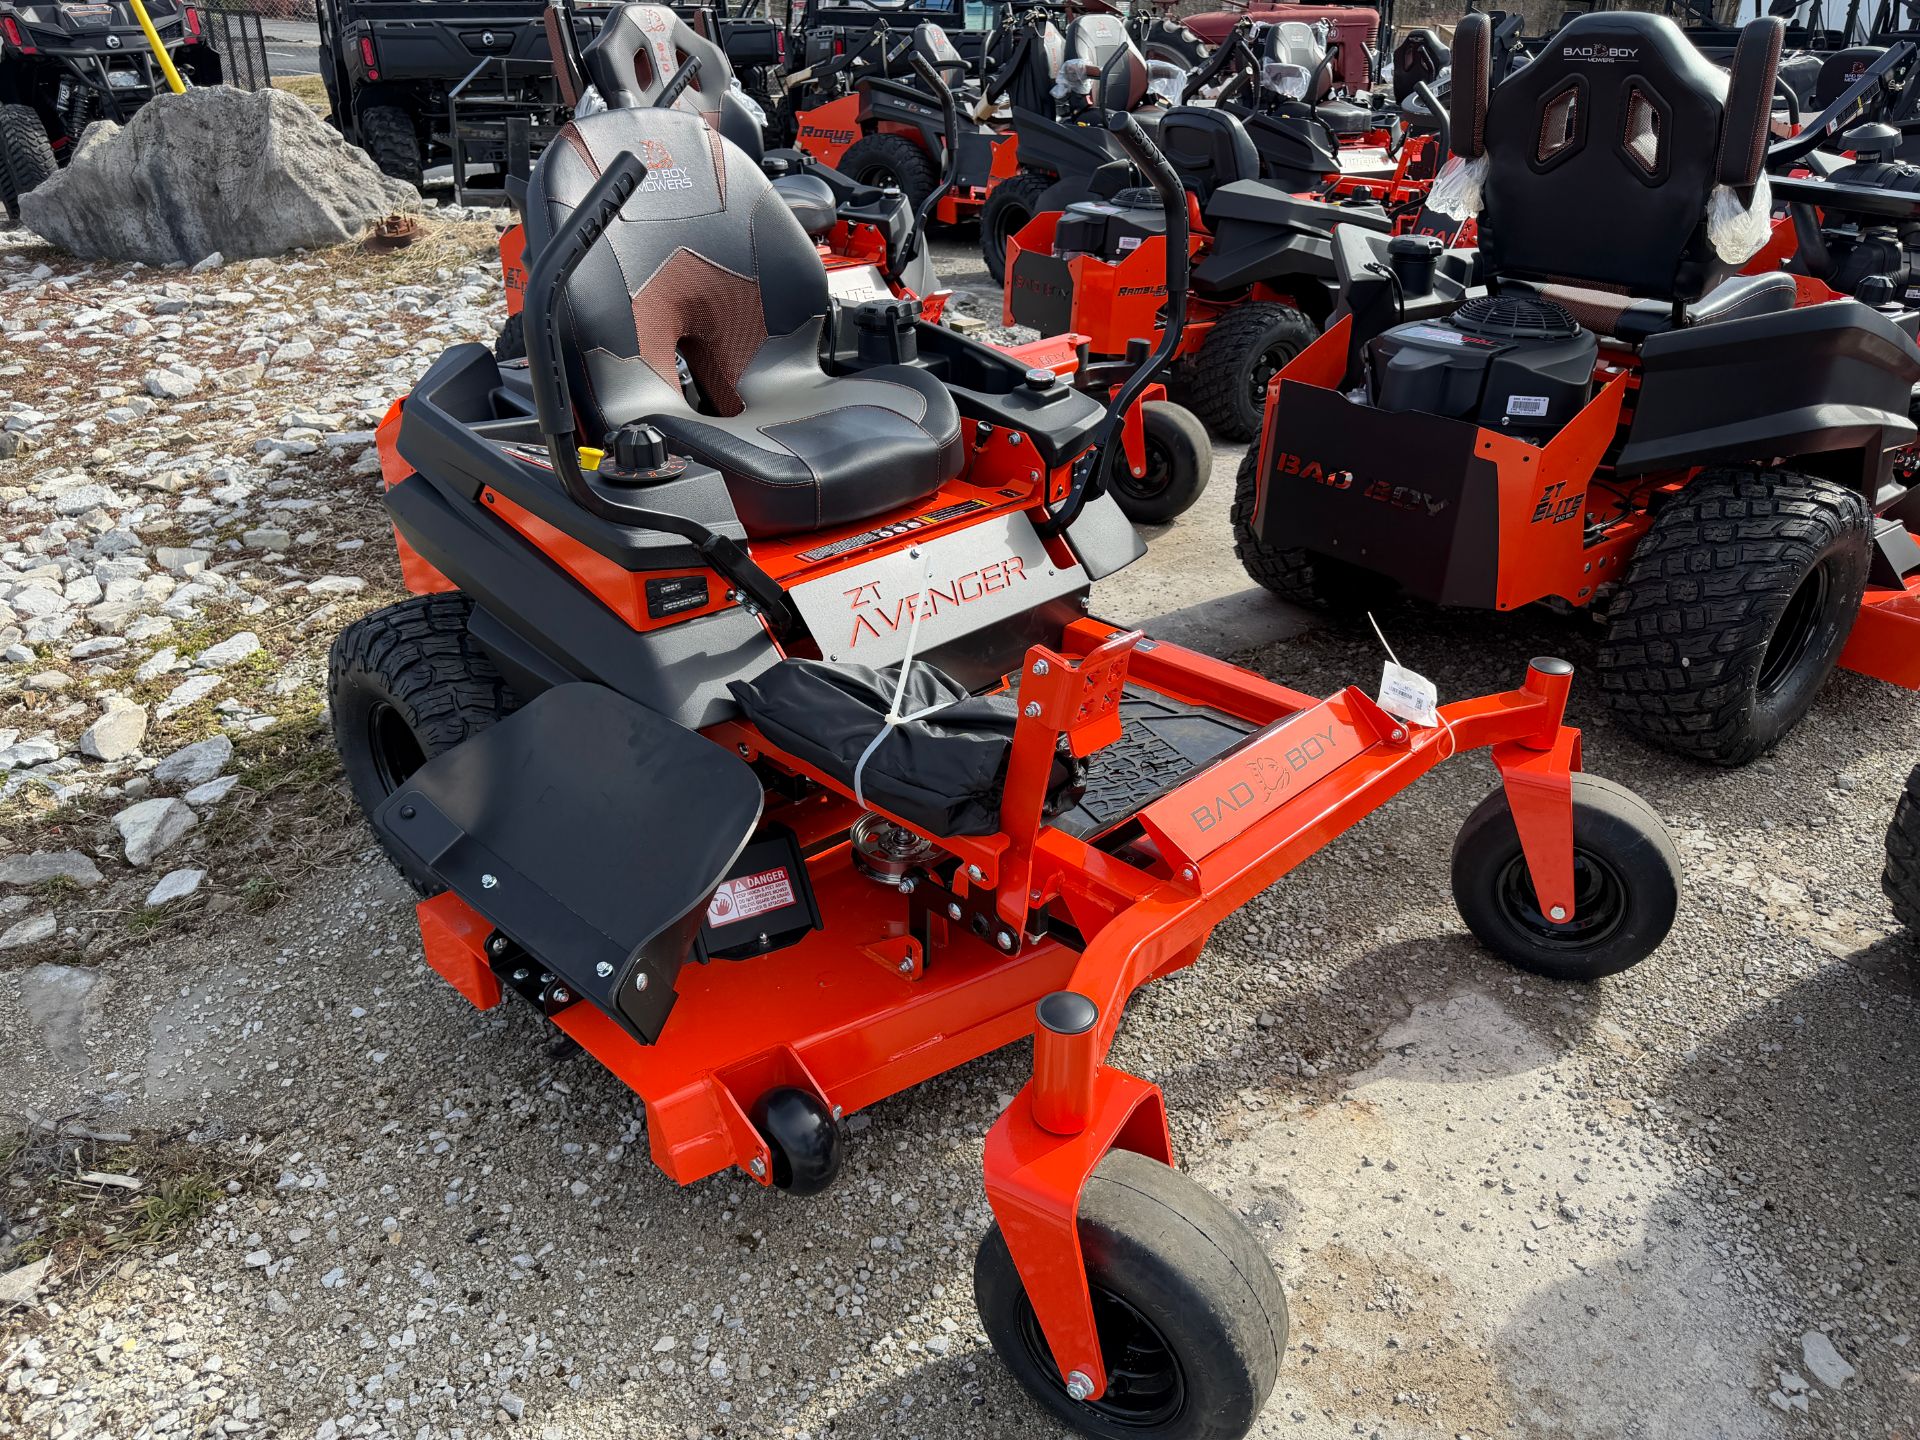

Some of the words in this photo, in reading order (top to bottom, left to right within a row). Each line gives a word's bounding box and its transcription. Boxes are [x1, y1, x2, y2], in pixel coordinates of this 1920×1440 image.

[1563, 47, 1593, 56] BAD
[1609, 48, 1639, 57] BOY
[635, 177, 693, 193] MOWERS
[662, 167, 687, 179] BOY
[575, 171, 636, 250] BAD
[1276, 452, 1354, 490] BAD
[1364, 479, 1450, 517] BOY
[1540, 480, 1567, 502] ZT
[1531, 493, 1585, 524] ELITE
[843, 580, 881, 609] ZT
[850, 556, 1027, 648] AVENGER
[1190, 781, 1255, 833] BAD
[1285, 725, 1337, 772] BOY
[747, 870, 785, 888] DANGER
